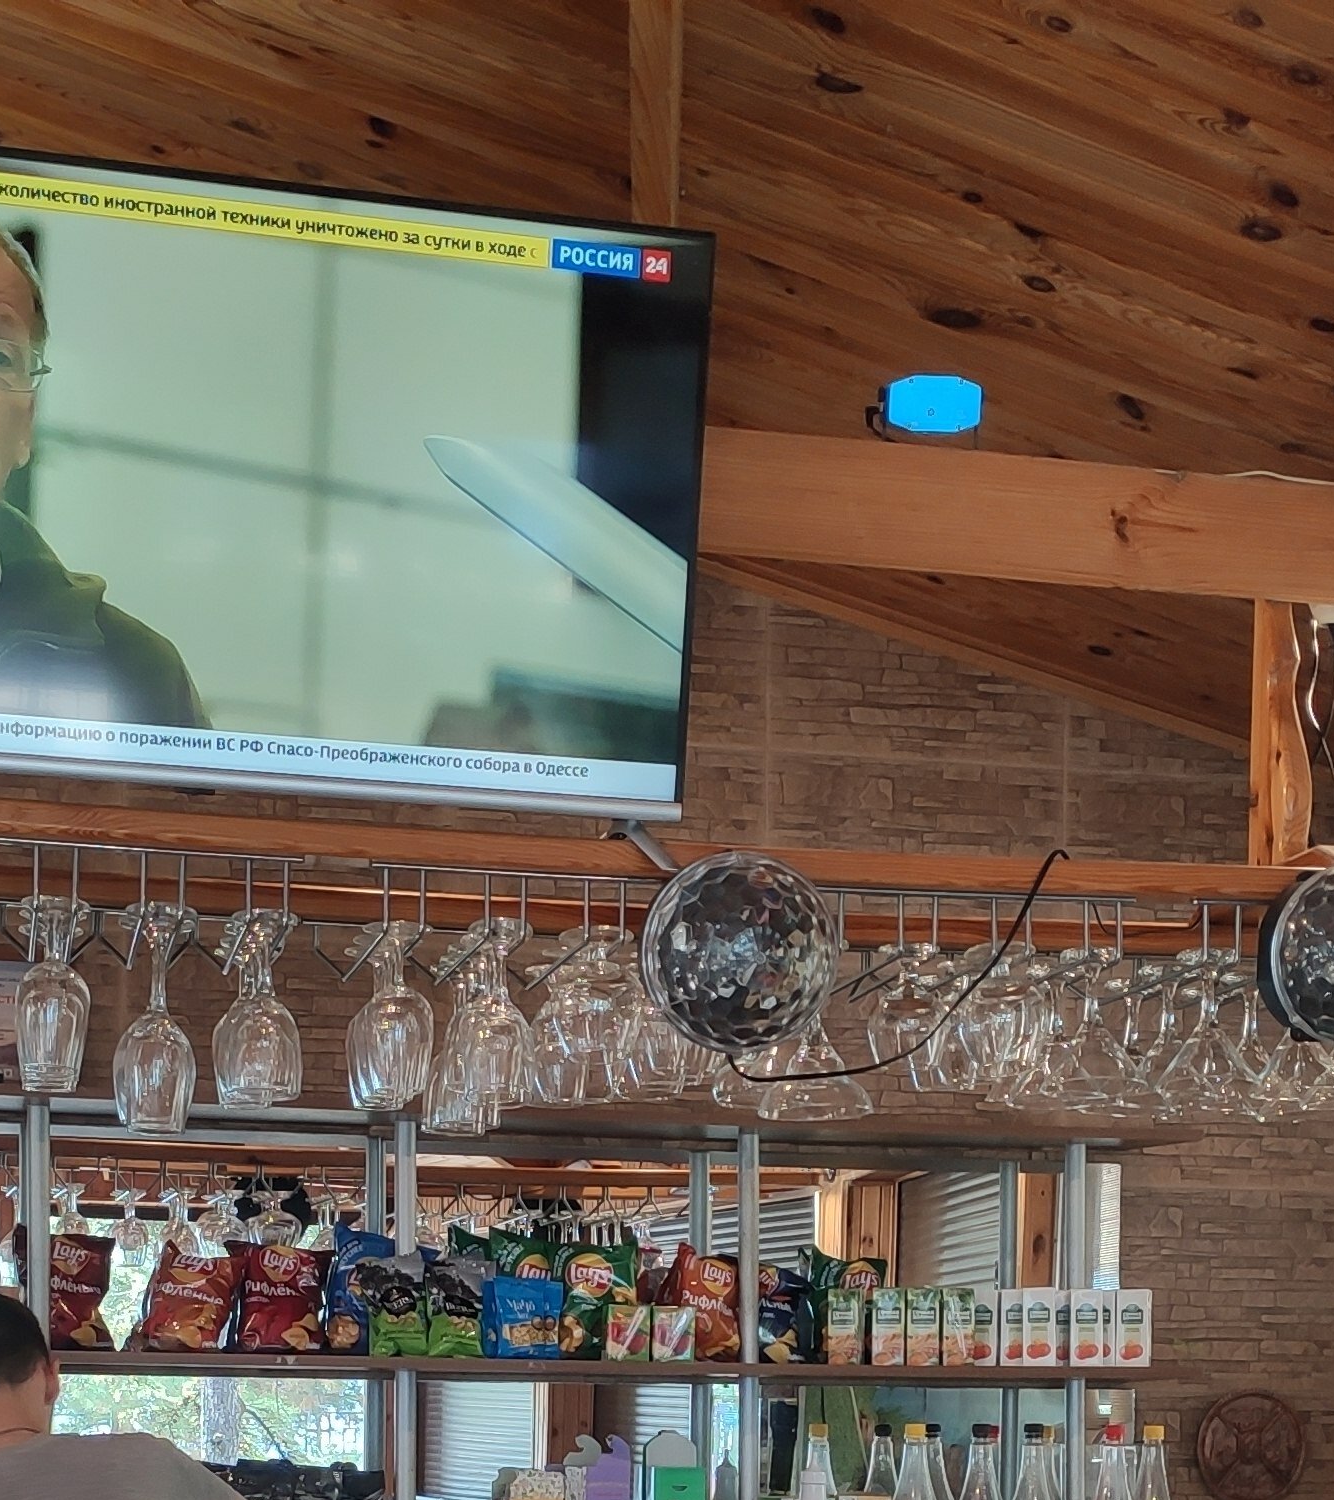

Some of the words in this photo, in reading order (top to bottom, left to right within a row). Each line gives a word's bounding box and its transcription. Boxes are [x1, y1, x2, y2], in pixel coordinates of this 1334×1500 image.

[0, 183, 100, 208] количество
[104, 195, 216, 221] иностранной
[221, 209, 292, 230] техники
[294, 219, 399, 242] уничтожено
[402, 231, 420, 245] за
[424, 233, 472, 251] сутки
[475, 241, 485, 252] в
[488, 242, 527, 258] ходе
[560, 245, 634, 271] РОССИЯ
[646, 255, 668, 275] 24
[106, 729, 116, 741] о
[119, 731, 212, 751] поражении
[216, 737, 235, 751] ВС
[239, 740, 264, 752] РФ
[267, 741, 462, 769] Спасо-Преображенского
[465, 757, 520, 773] собора
[524, 762, 533, 774] в
[536, 761, 589, 778] Одессе
